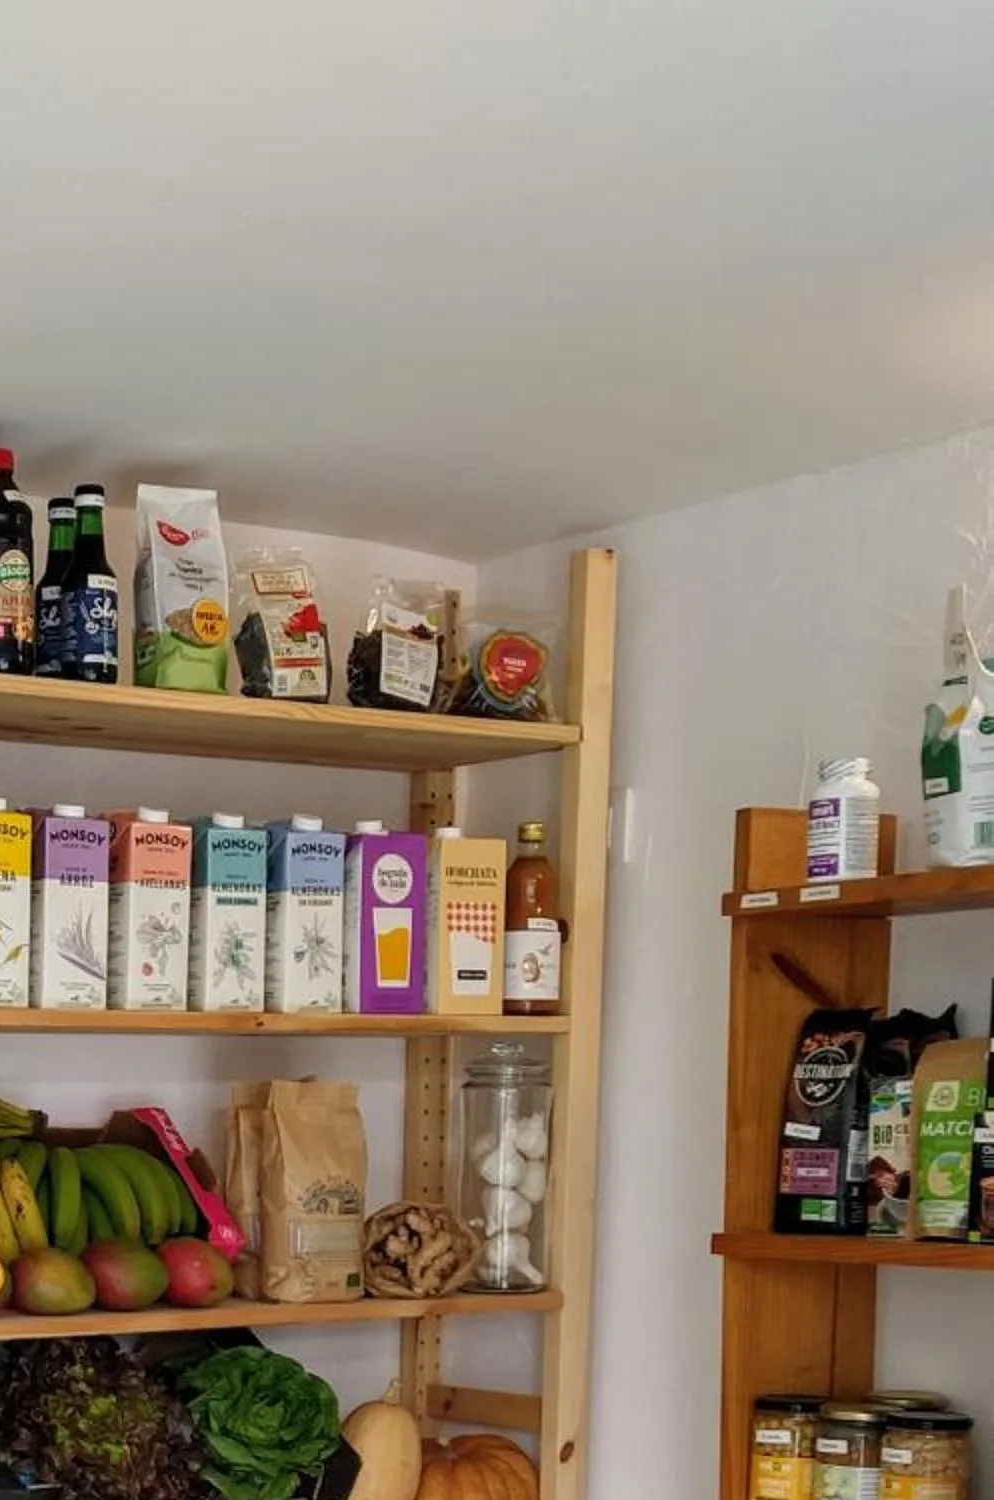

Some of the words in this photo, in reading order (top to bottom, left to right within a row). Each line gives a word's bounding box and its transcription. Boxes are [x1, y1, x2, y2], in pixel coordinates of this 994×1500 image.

[49, 828, 106, 846] MONSOY
[135, 833, 189, 849] MONSOY
[211, 838, 265, 854] MONSOY
[291, 842, 342, 858] MONSOY
